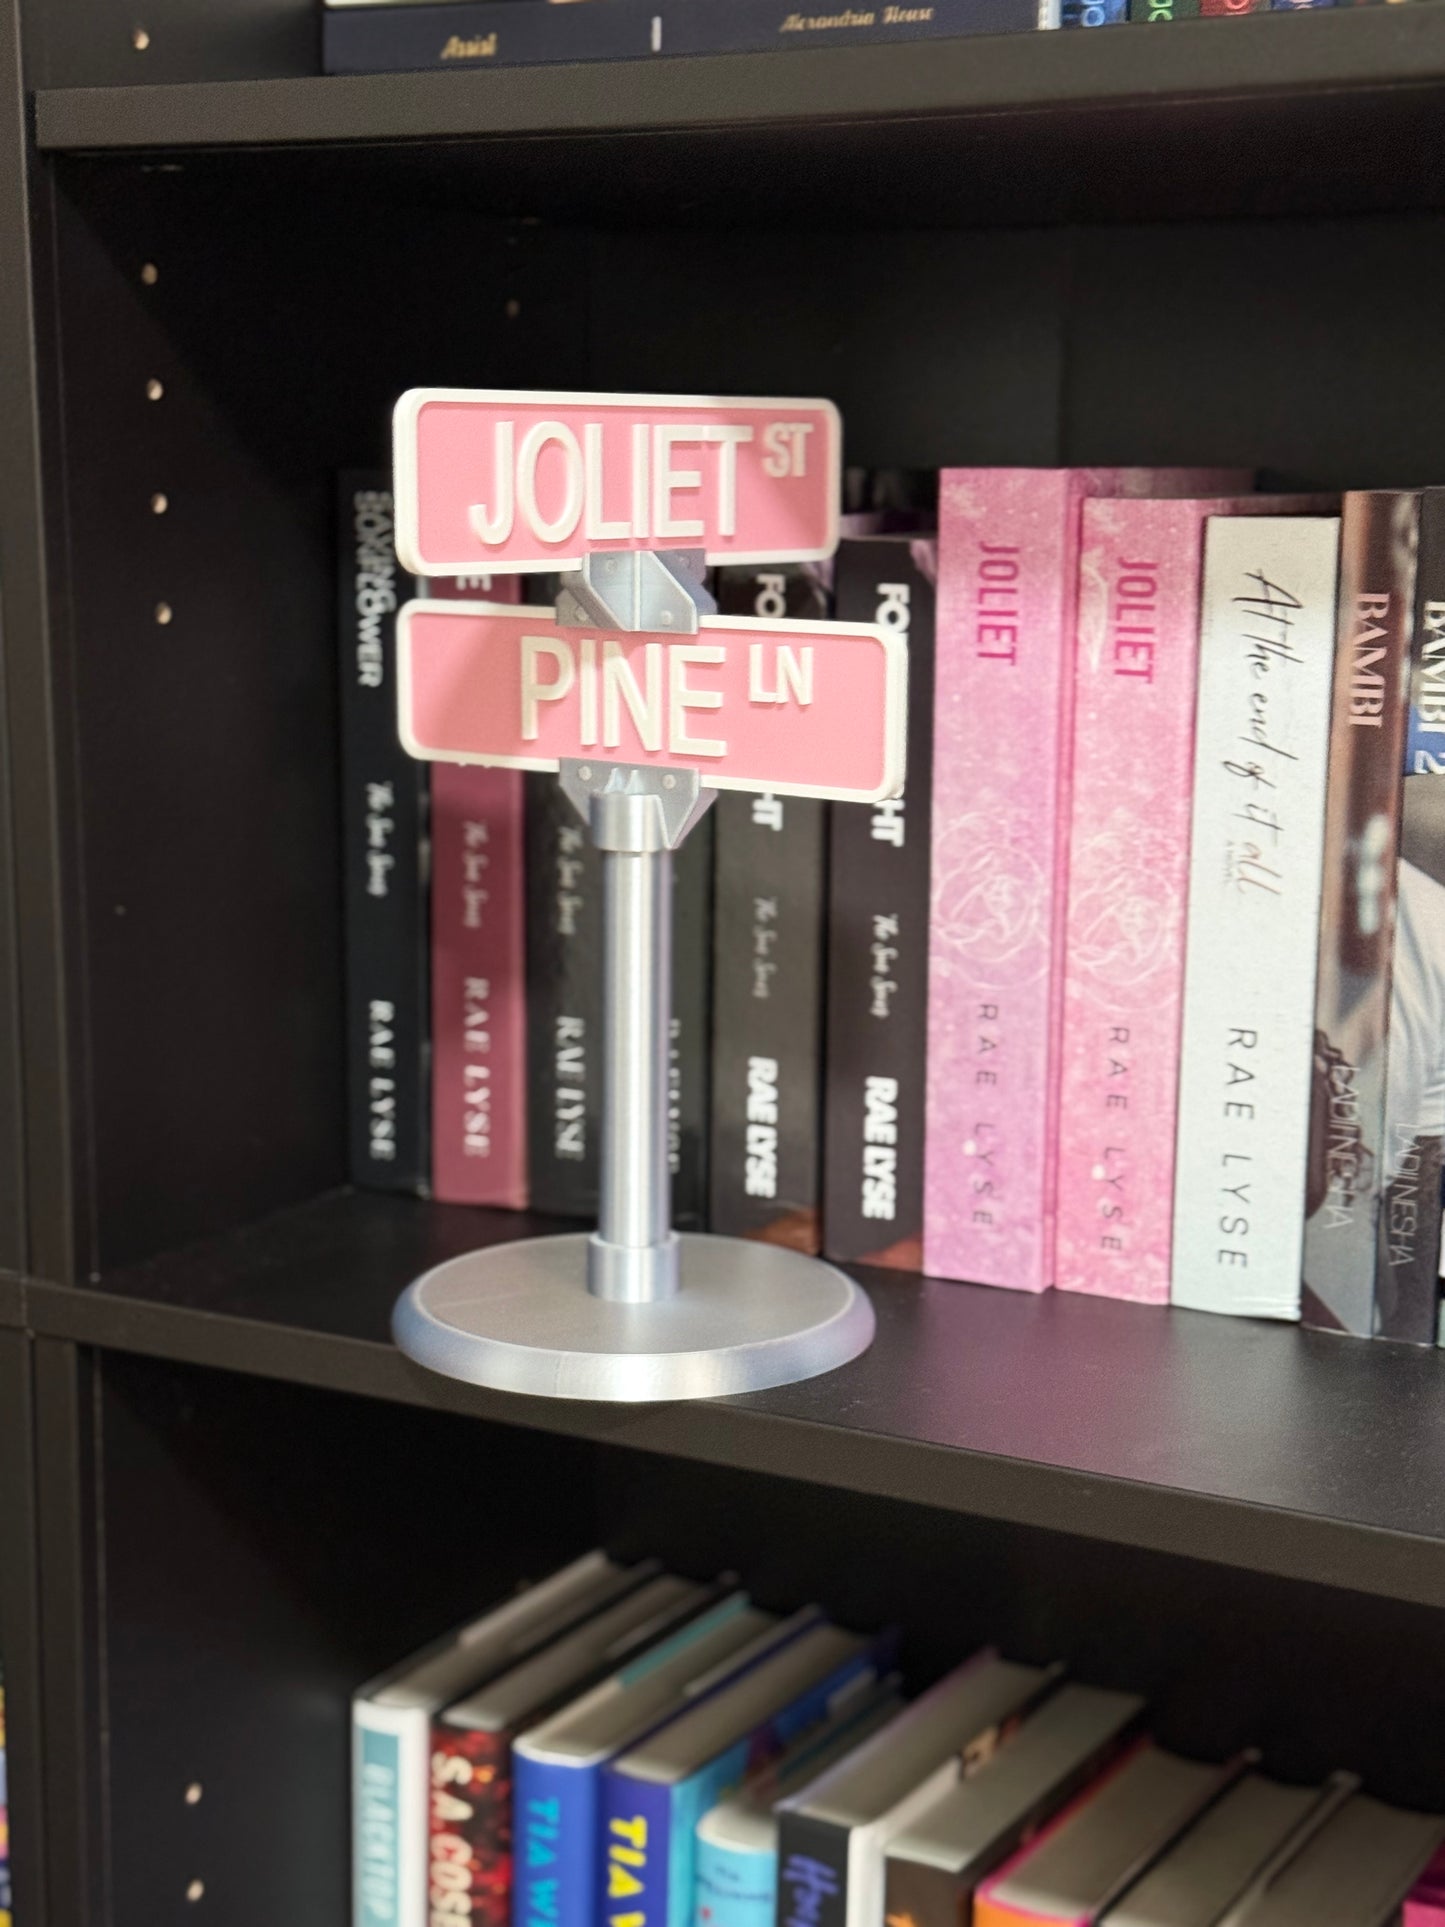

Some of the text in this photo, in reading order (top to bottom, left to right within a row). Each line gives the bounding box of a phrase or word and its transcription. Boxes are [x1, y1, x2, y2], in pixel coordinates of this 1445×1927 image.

[882, 5, 934, 24] House
[468, 421, 814, 545] JOLIET ST
[978, 541, 1020, 666] JOLIET
[1114, 557, 1160, 684] JOLIET
[1349, 592, 1390, 728] BAMBI
[1417, 600, 1445, 733] BAMBI
[520, 635, 813, 757] PINE LN
[1238, 692, 1299, 761] end
[1222, 760, 1277, 791] of
[1232, 803, 1285, 848] it
[1236, 842, 1284, 894] all
[369, 999, 396, 1161] RAE LYSE
[464, 977, 491, 1158] RAE LYSE
[556, 1016, 585, 1161] RAE LYSE
[745, 1056, 778, 1198] RAE LYSE
[972, 1003, 999, 1226] RAE LYSE
[862, 1075, 898, 1221] RAE LYSE
[1101, 1025, 1130, 1251] RAE LYSE
[1218, 1028, 1259, 1268] RAE LYSE
[527, 1798, 560, 1868] TIA
[608, 1814, 648, 1898] TIA
